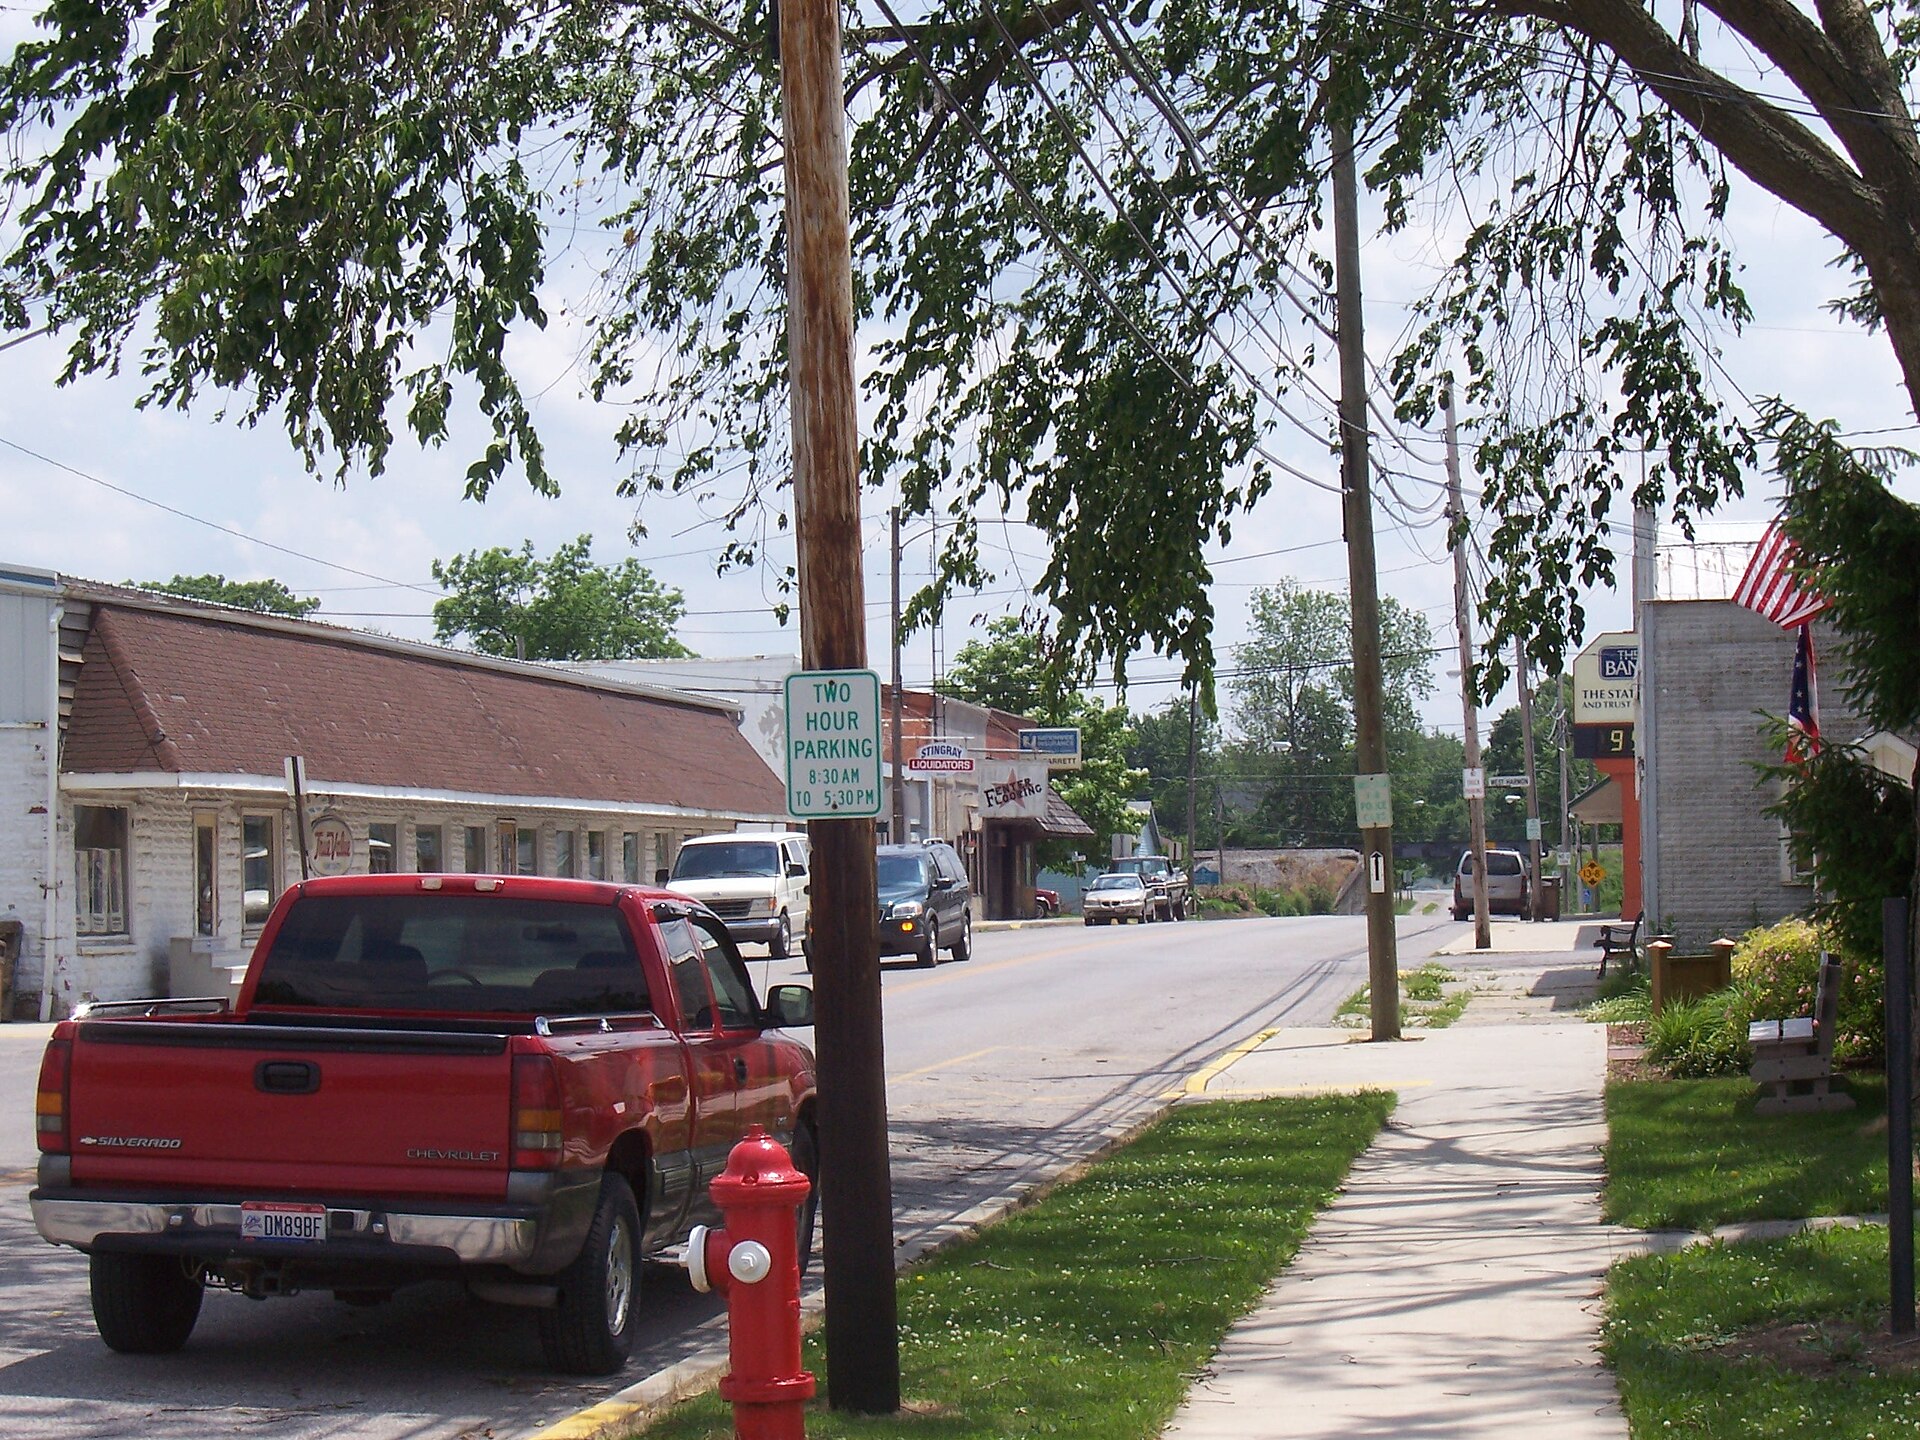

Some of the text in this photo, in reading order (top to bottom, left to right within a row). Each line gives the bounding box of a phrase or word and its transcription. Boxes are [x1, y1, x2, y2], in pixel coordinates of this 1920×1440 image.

[1605, 660, 1638, 677] BAN
[813, 682, 851, 703] TWO
[1582, 689, 1634, 699] THE STAT
[1604, 701, 1630, 709] TRUST
[806, 711, 859, 731] HOUR
[794, 739, 873, 759] PARKING
[921, 745, 963, 759] STINGRAY
[911, 760, 971, 770] LIQUIDATORS
[809, 768, 860, 784] 8:30 AM
[796, 789, 874, 807] TO 5:30 PM
[97, 1137, 181, 1149] SILVERADO
[407, 1149, 500, 1161] CHEVROLET
[264, 1215, 322, 1238] DM89BF
